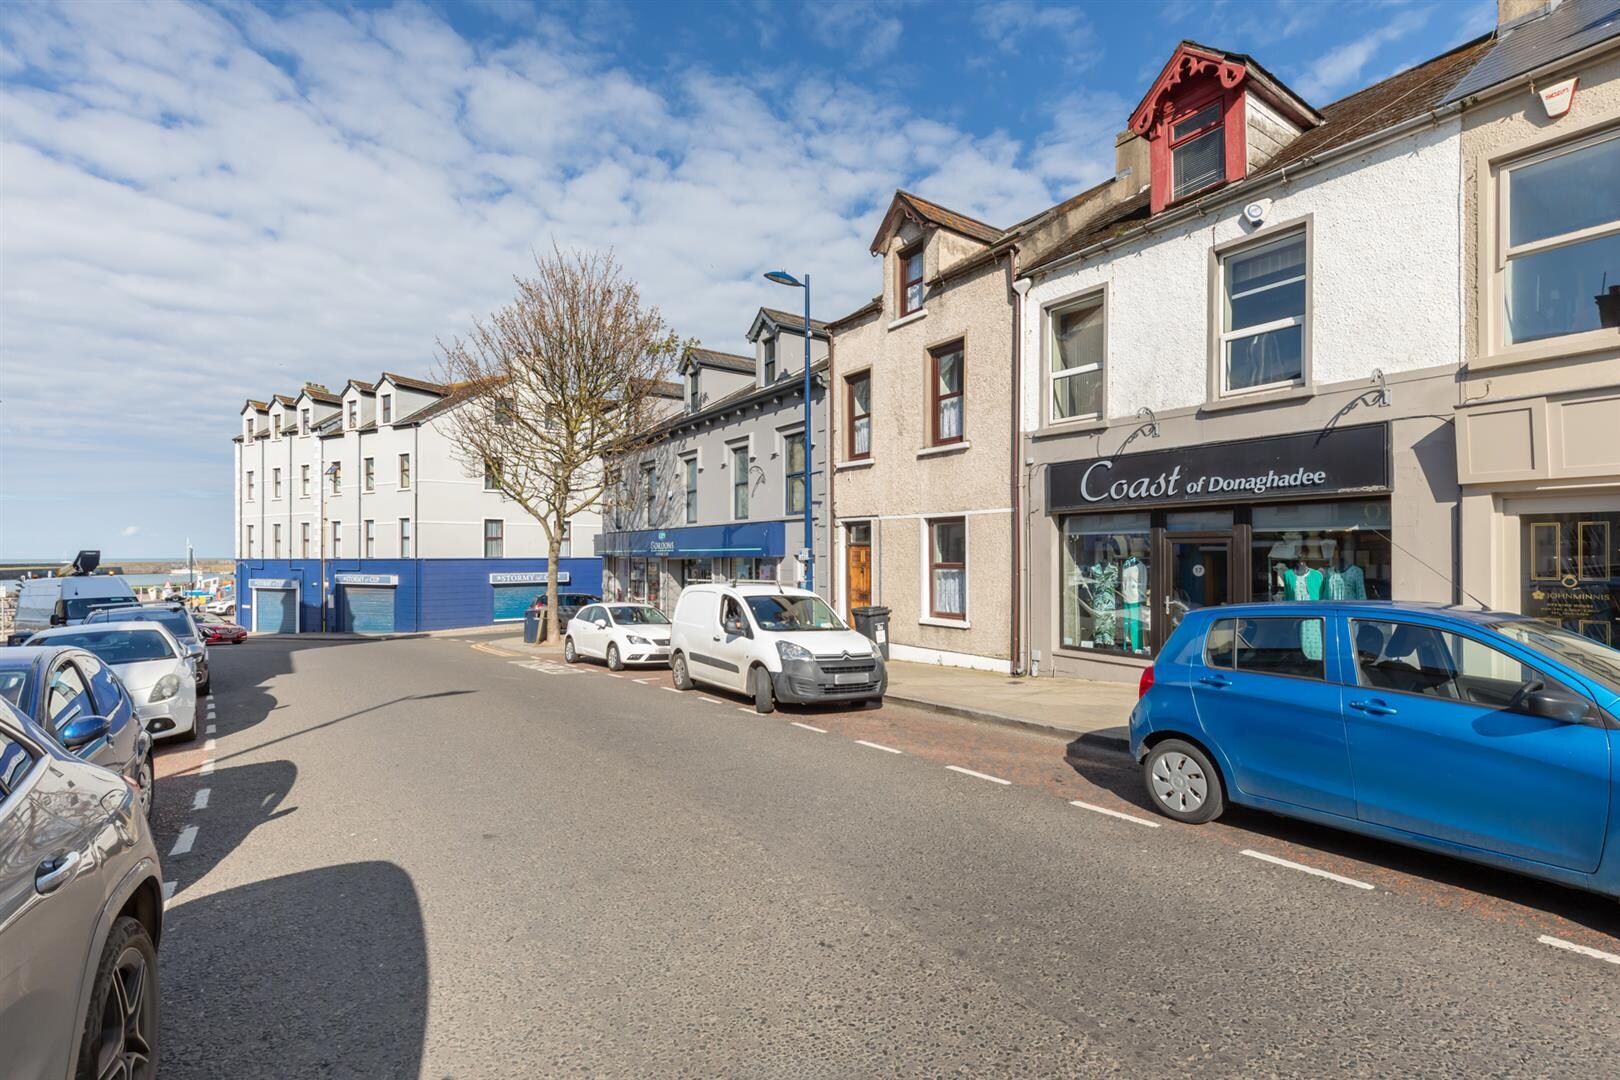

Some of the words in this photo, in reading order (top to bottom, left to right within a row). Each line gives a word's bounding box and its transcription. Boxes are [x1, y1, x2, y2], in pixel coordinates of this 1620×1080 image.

[1081, 460, 1181, 502] Coast
[1186, 476, 1206, 494] of
[1208, 467, 1326, 493] Donaghadee
